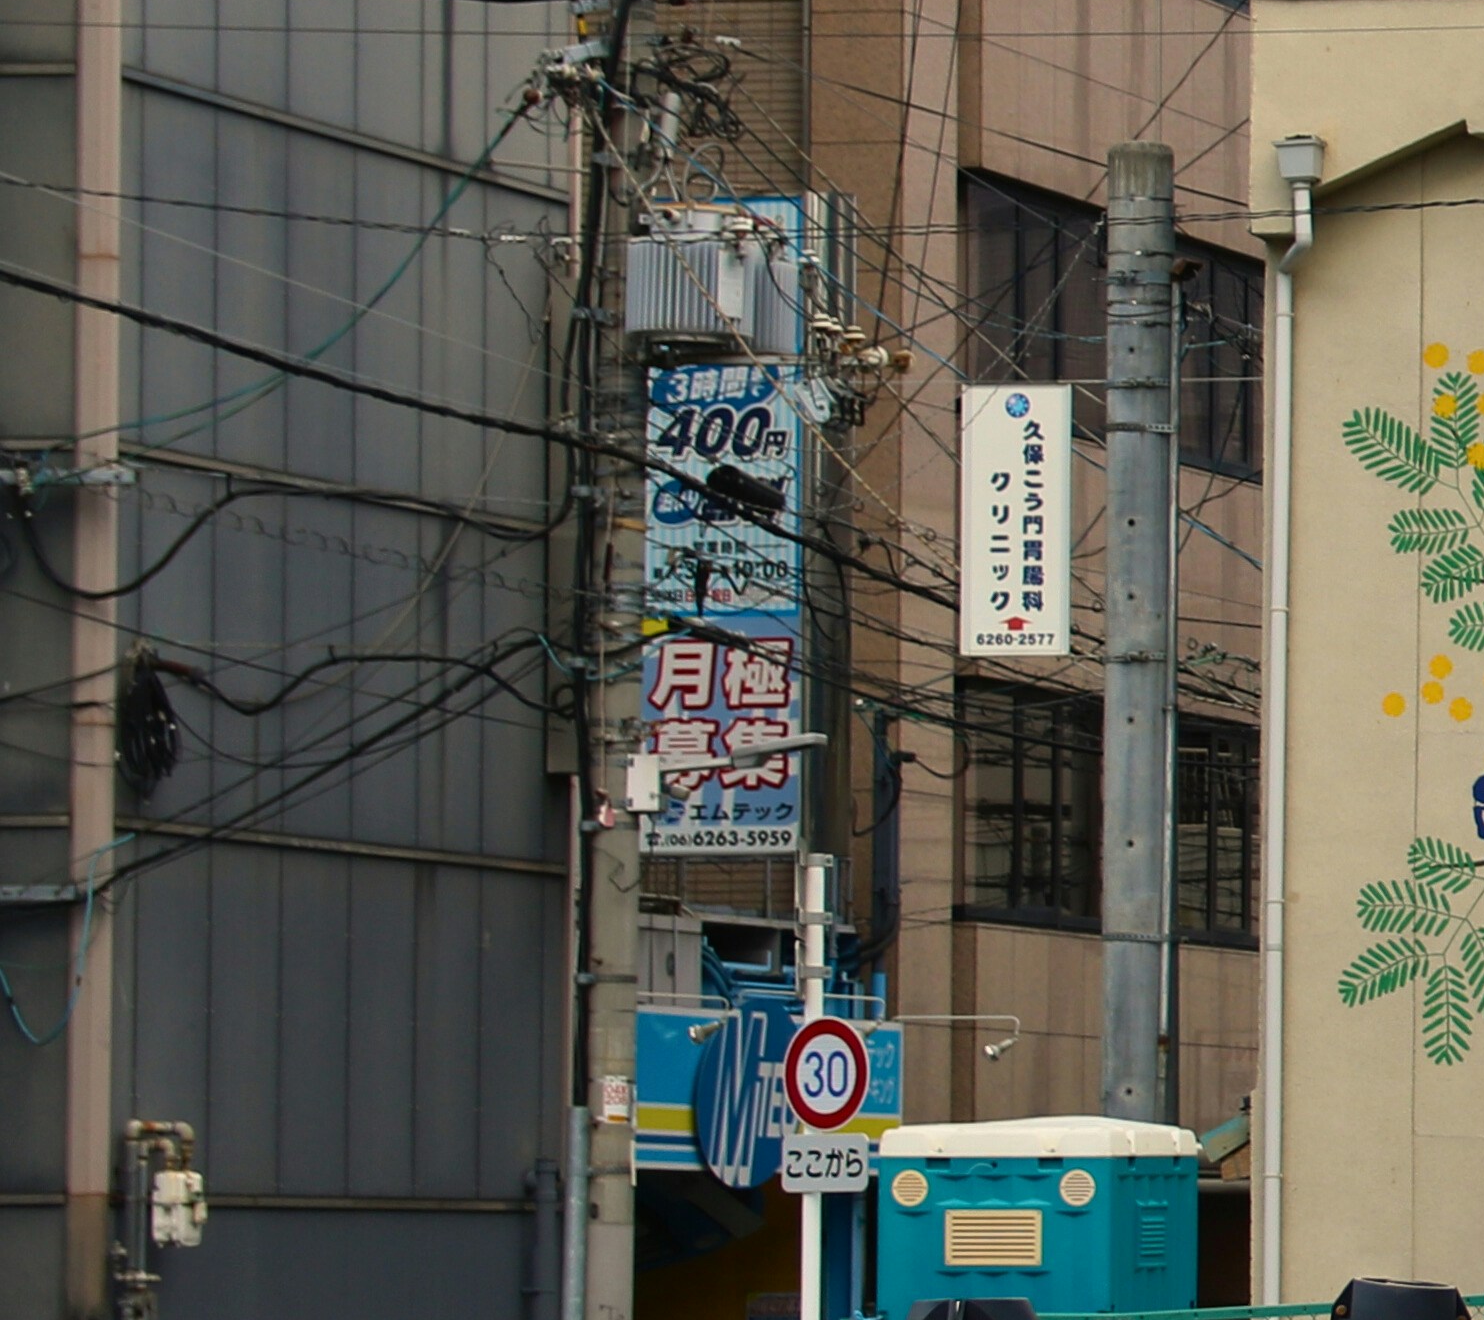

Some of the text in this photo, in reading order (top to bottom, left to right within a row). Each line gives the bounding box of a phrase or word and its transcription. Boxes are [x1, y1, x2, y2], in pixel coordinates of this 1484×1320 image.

[658, 407, 787, 458] 400円
[1022, 420, 1045, 611] 久保こう門胃腸科
[990, 472, 1011, 611] クリニック
[976, 633, 1055, 646] 6260-2577
[649, 637, 793, 710] 月極
[650, 717, 788, 790] 募集
[690, 802, 793, 822] エムテック
[803, 1050, 849, 1098] 30
[786, 1148, 864, 1179] ここから
